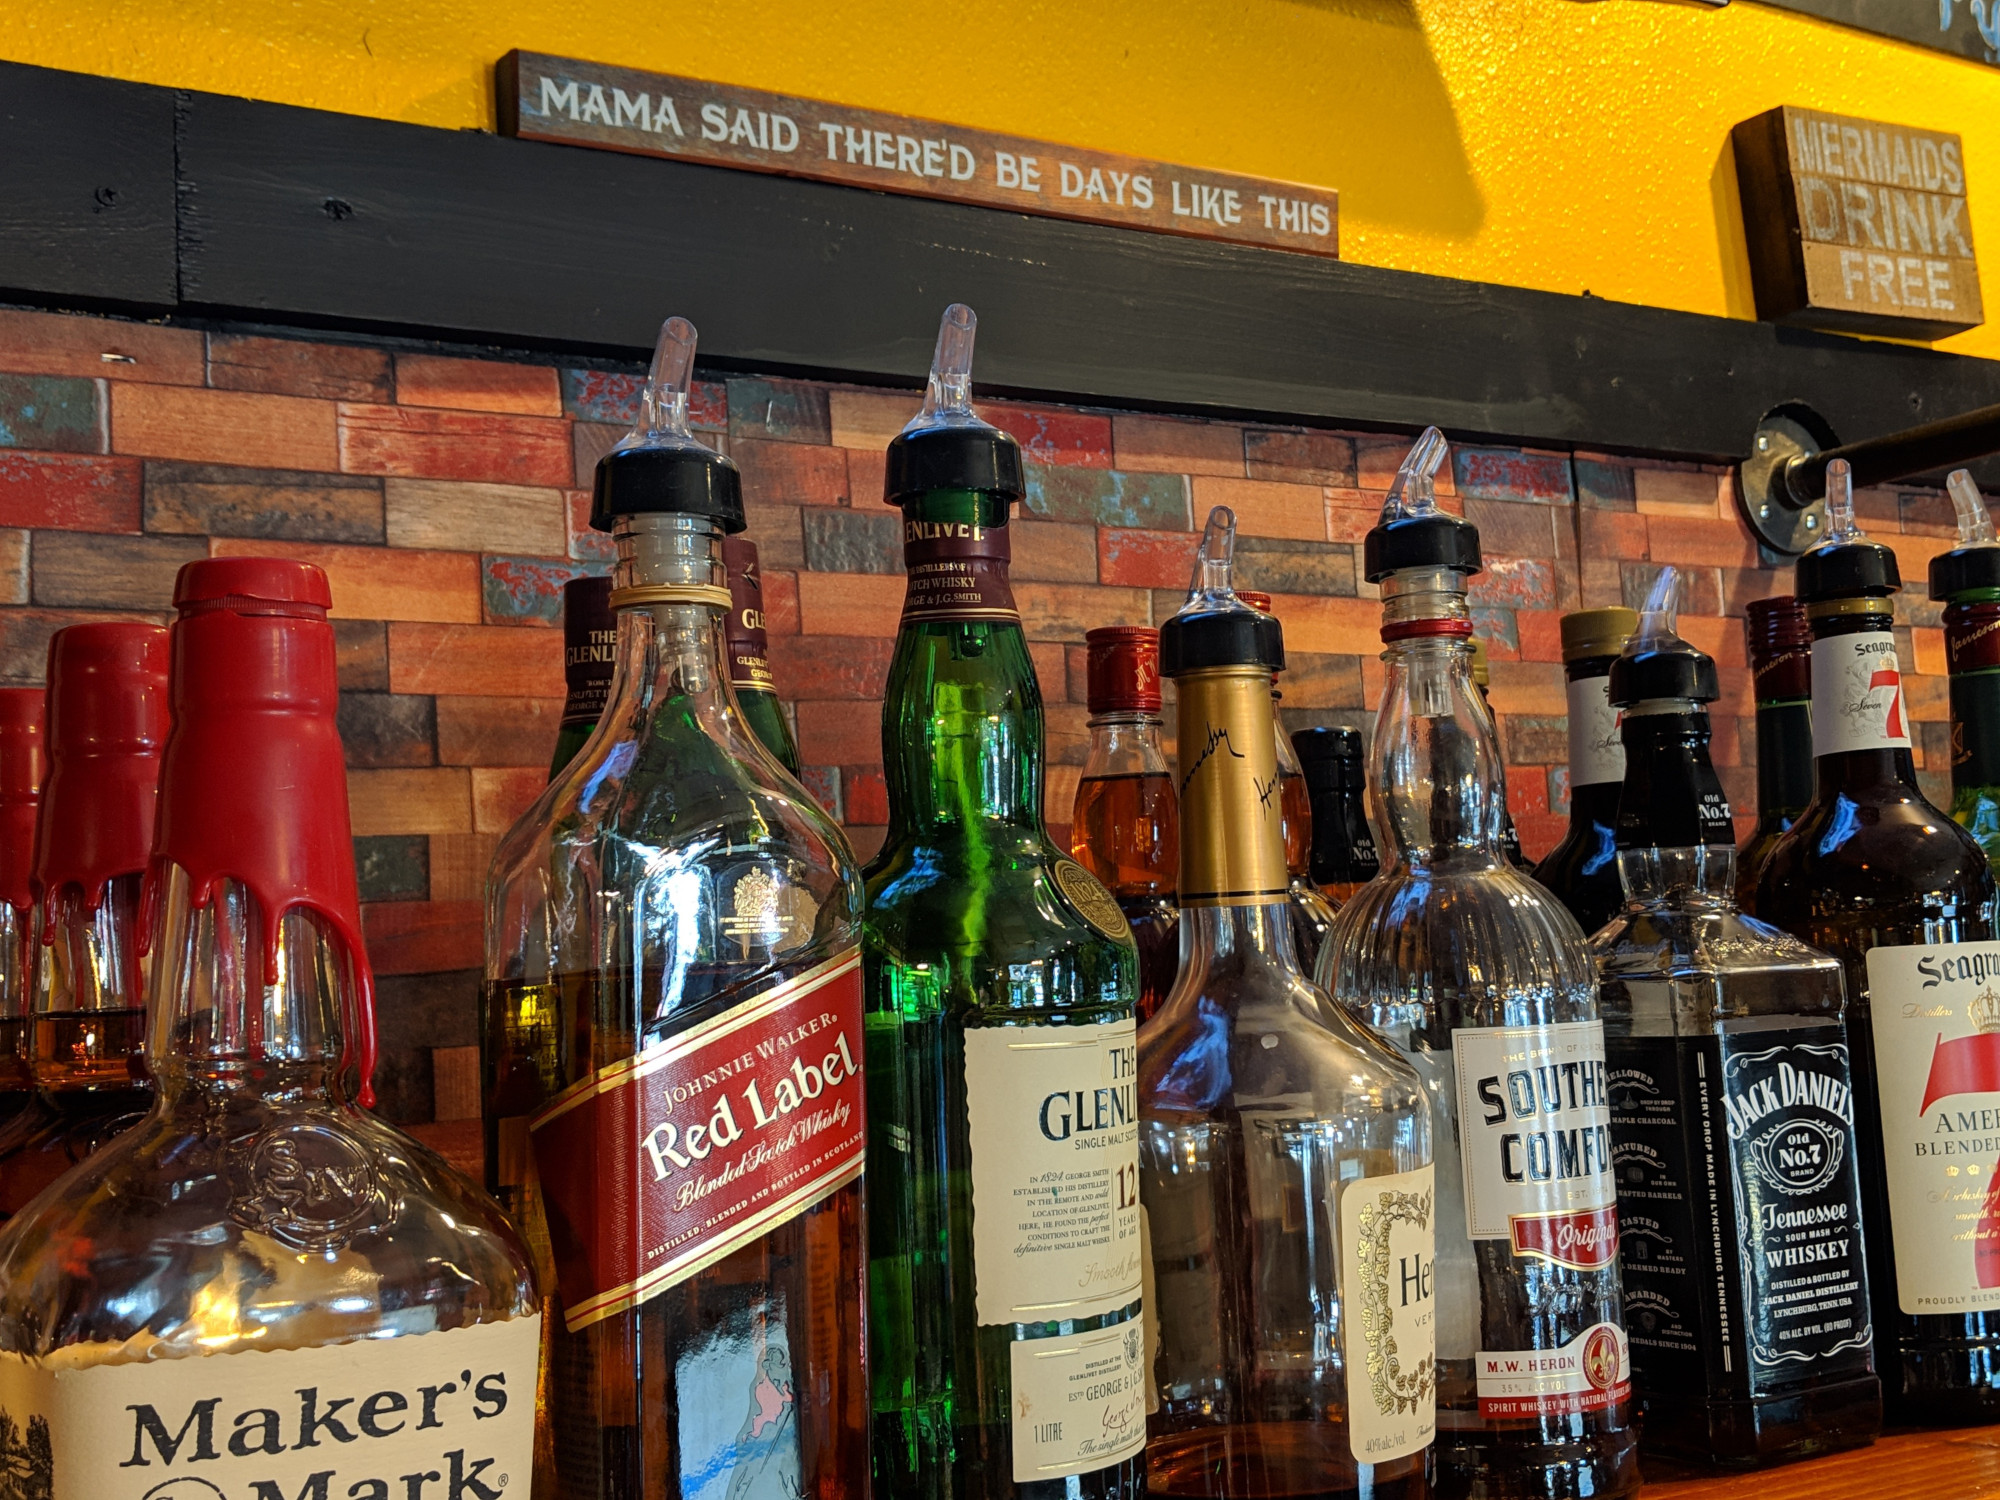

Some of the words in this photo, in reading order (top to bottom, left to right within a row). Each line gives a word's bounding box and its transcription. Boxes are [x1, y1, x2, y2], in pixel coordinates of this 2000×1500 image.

[539, 76, 685, 136] MAMA
[700, 104, 800, 153] SAID
[819, 122, 976, 182] THERE'D
[995, 151, 1042, 193] BE
[1059, 163, 1154, 209] DAYS
[1171, 181, 1243, 227] LIKE
[1257, 195, 1331, 236] THIS
[1794, 117, 1964, 195] MERMAIDS
[1801, 177, 1974, 259] DRINK
[1840, 250, 1956, 311] FREE
[931, 576, 976, 589] WHISKY
[589, 630, 617, 644] THE
[1849, 697, 1882, 712] Seven
[1868, 669, 1908, 738] 7
[1704, 794, 1720, 803] Old
[1699, 803, 1732, 819] No.7
[1902, 1002, 1953, 1019] Distillers
[1109, 1045, 1136, 1080] THE
[1502, 1052, 1525, 1063] THE
[663, 1052, 755, 1115] JOHNNIE
[641, 1093, 744, 1183] Red
[742, 1031, 859, 1130] Label
[1699, 1081, 1710, 1118] EVERY
[1720, 1075, 1782, 1140] JACK
[1637, 1117, 1677, 1125] CHARCOAL
[1075, 1135, 1106, 1150] SINGLE
[1108, 1132, 1124, 1146] MALT
[1703, 1120, 1713, 1151] DROP
[1787, 1133, 1809, 1145] Old
[674, 1152, 748, 1212] Blended
[744, 1124, 798, 1172] Scotch
[793, 1099, 851, 1143] Whisky
[1611, 1142, 1657, 1158] MATURED
[1779, 1144, 1821, 1169] No.7
[706, 1200, 748, 1227] BLENDED
[752, 1188, 769, 1204] AND
[771, 1164, 811, 1191] BOTTLED
[813, 1157, 823, 1167] IN
[825, 1130, 864, 1161] SCOTLAND
[1065, 1171, 1091, 1180] GEORGE
[1092, 1168, 1109, 1177] SMITH
[1706, 1154, 1716, 1186] MADE
[1790, 1168, 1814, 1177] BRAND
[1065, 1184, 1076, 1192] HIS
[1077, 1180, 1109, 1190] DISTILLERY
[1116, 1161, 1136, 1212] 12
[1709, 1189, 1717, 1201] IN
[1027, 1199, 1036, 1207] IN
[1037, 1197, 1053, 1206] THE
[1054, 1195, 1080, 1204] REMOTE
[1081, 1193, 1094, 1201] AND
[1032, 1208, 1068, 1218] LOCATION
[1043, 1221, 1053, 1229] HE
[1054, 1219, 1077, 1228] FOUND
[1077, 1217, 1090, 1225] THE
[1089, 1211, 1110, 1227] perfect
[1761, 1203, 1848, 1231] Tennessee
[1620, 1216, 1660, 1230] TASTED
[1027, 1230, 1069, 1241] CONDITIONS
[1070, 1229, 1080, 1237] TO
[1080, 1226, 1099, 1235] CRAFT
[1118, 1230, 1127, 1240] OF
[1558, 1217, 1616, 1251] Original
[1710, 1204, 1723, 1272] LYNCHBURG
[1785, 1232, 1806, 1243] SOUR
[1809, 1229, 1831, 1239] MASH
[1013, 1242, 1053, 1258] definitive
[1054, 1241, 1075, 1250] SINGLE
[1076, 1239, 1091, 1248] MALT
[1766, 1239, 1850, 1268] WHISKEY
[1627, 1263, 1659, 1272] DEEMED
[1660, 1266, 1687, 1275] READY
[1771, 1277, 1806, 1290] DISTILLED
[1812, 1271, 1841, 1283] BOTTLED
[1841, 1269, 1850, 1278] BY
[1624, 1290, 1671, 1307] AWARDED
[1763, 1295, 1784, 1306] JACK
[1785, 1290, 1815, 1302] DANIEL
[1815, 1281, 1859, 1297] DISTILLERY
[1839, 1297, 1852, 1306] USA
[1918, 1296, 1966, 1306] PROUDLY
[1717, 1275, 1730, 1342] TENNESSEE
[1804, 1327, 1811, 1336] BY
[1630, 1337, 1658, 1346] MEDALS
[1658, 1341, 1680, 1349] SINCE
[1681, 1343, 1697, 1351] 1904
[1069, 1370, 1097, 1381] GLENLIVET
[1098, 1364, 1121, 1376] DISTILLERY
[1085, 1359, 1108, 1369] DISTILLED
[1487, 1361, 1523, 1373] M.W.
[1528, 1356, 1576, 1371] HERON
[1086, 1378, 1122, 1401] GEORGE
[1124, 1376, 1129, 1389] &
[1488, 1402, 1517, 1413] SPIRIT
[1521, 1400, 1557, 1413] WHISKEY
[1559, 1398, 1579, 1409] WITH
[1580, 1392, 1607, 1407] NATURAL
[119, 1369, 508, 1467] Maker's
[1041, 1422, 1063, 1443] LITRE
[1078, 1438, 1096, 1456] The
[1098, 1433, 1120, 1451] single
